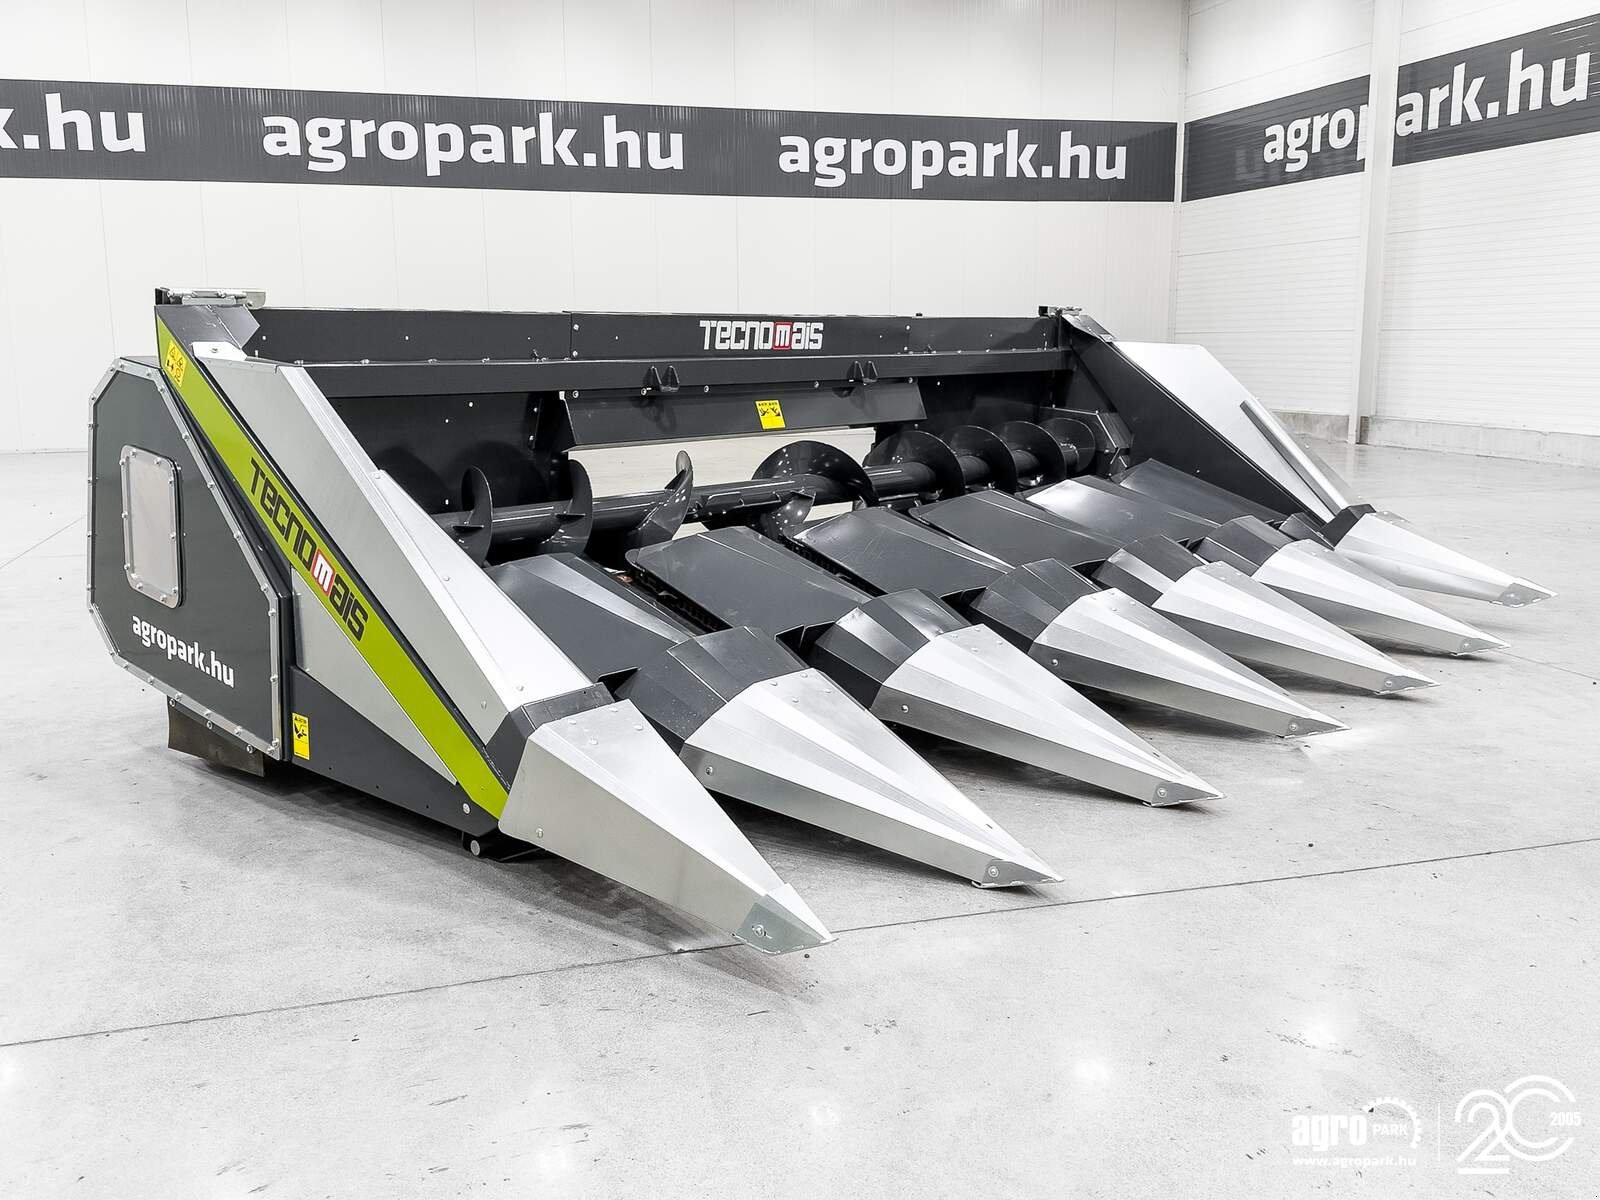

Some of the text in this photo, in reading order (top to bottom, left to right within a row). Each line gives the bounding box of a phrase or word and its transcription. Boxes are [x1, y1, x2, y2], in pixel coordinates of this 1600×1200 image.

[262, 111, 684, 177] agropark.hu
[778, 128, 1127, 190] agropark.hu
[132, 615, 234, 688] agropark.hu
